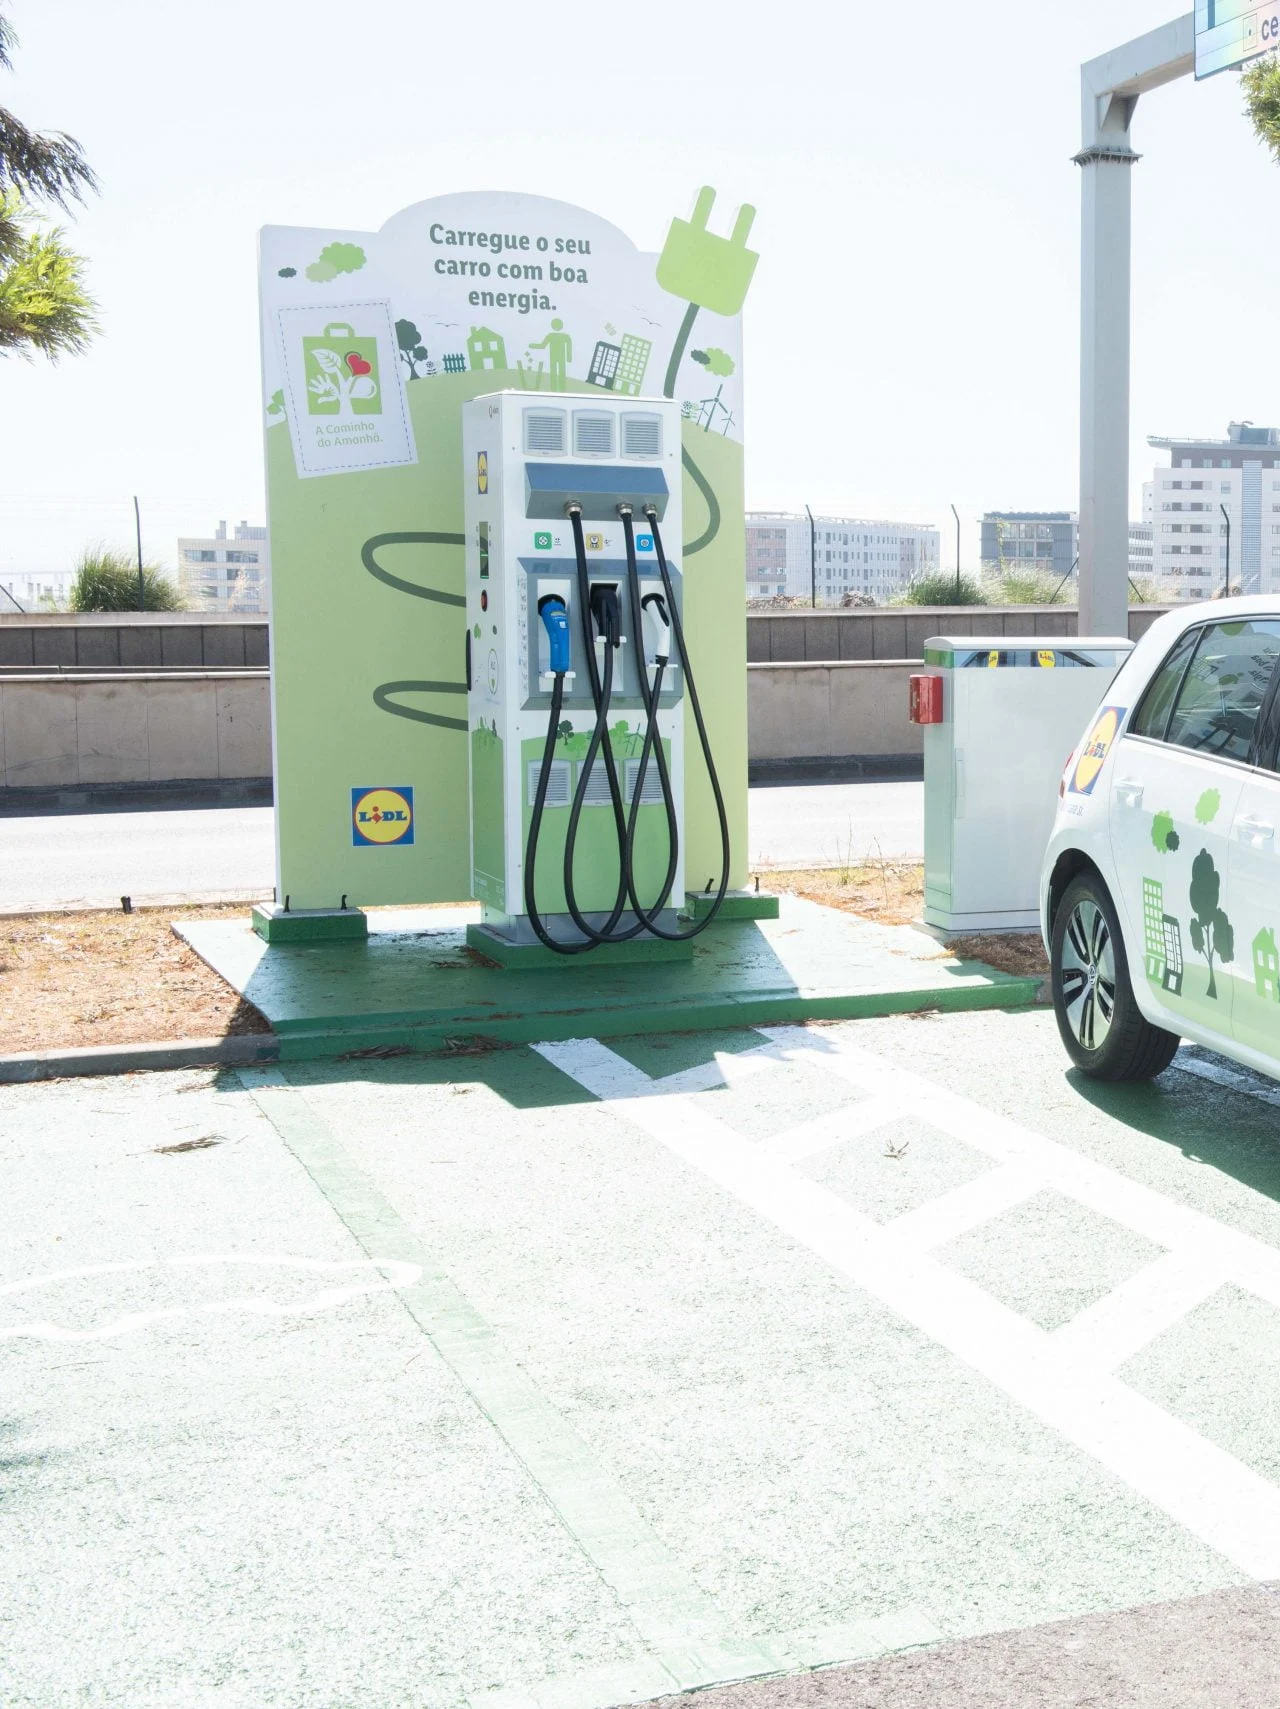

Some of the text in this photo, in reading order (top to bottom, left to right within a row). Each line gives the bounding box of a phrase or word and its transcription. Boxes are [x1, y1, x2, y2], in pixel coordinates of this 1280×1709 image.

[429, 223, 592, 255] Carregue o seu
[434, 258, 588, 284] carro com boa
[468, 288, 557, 314] energia.
[316, 421, 375, 435] A Caminho
[317, 438, 331, 447] do
